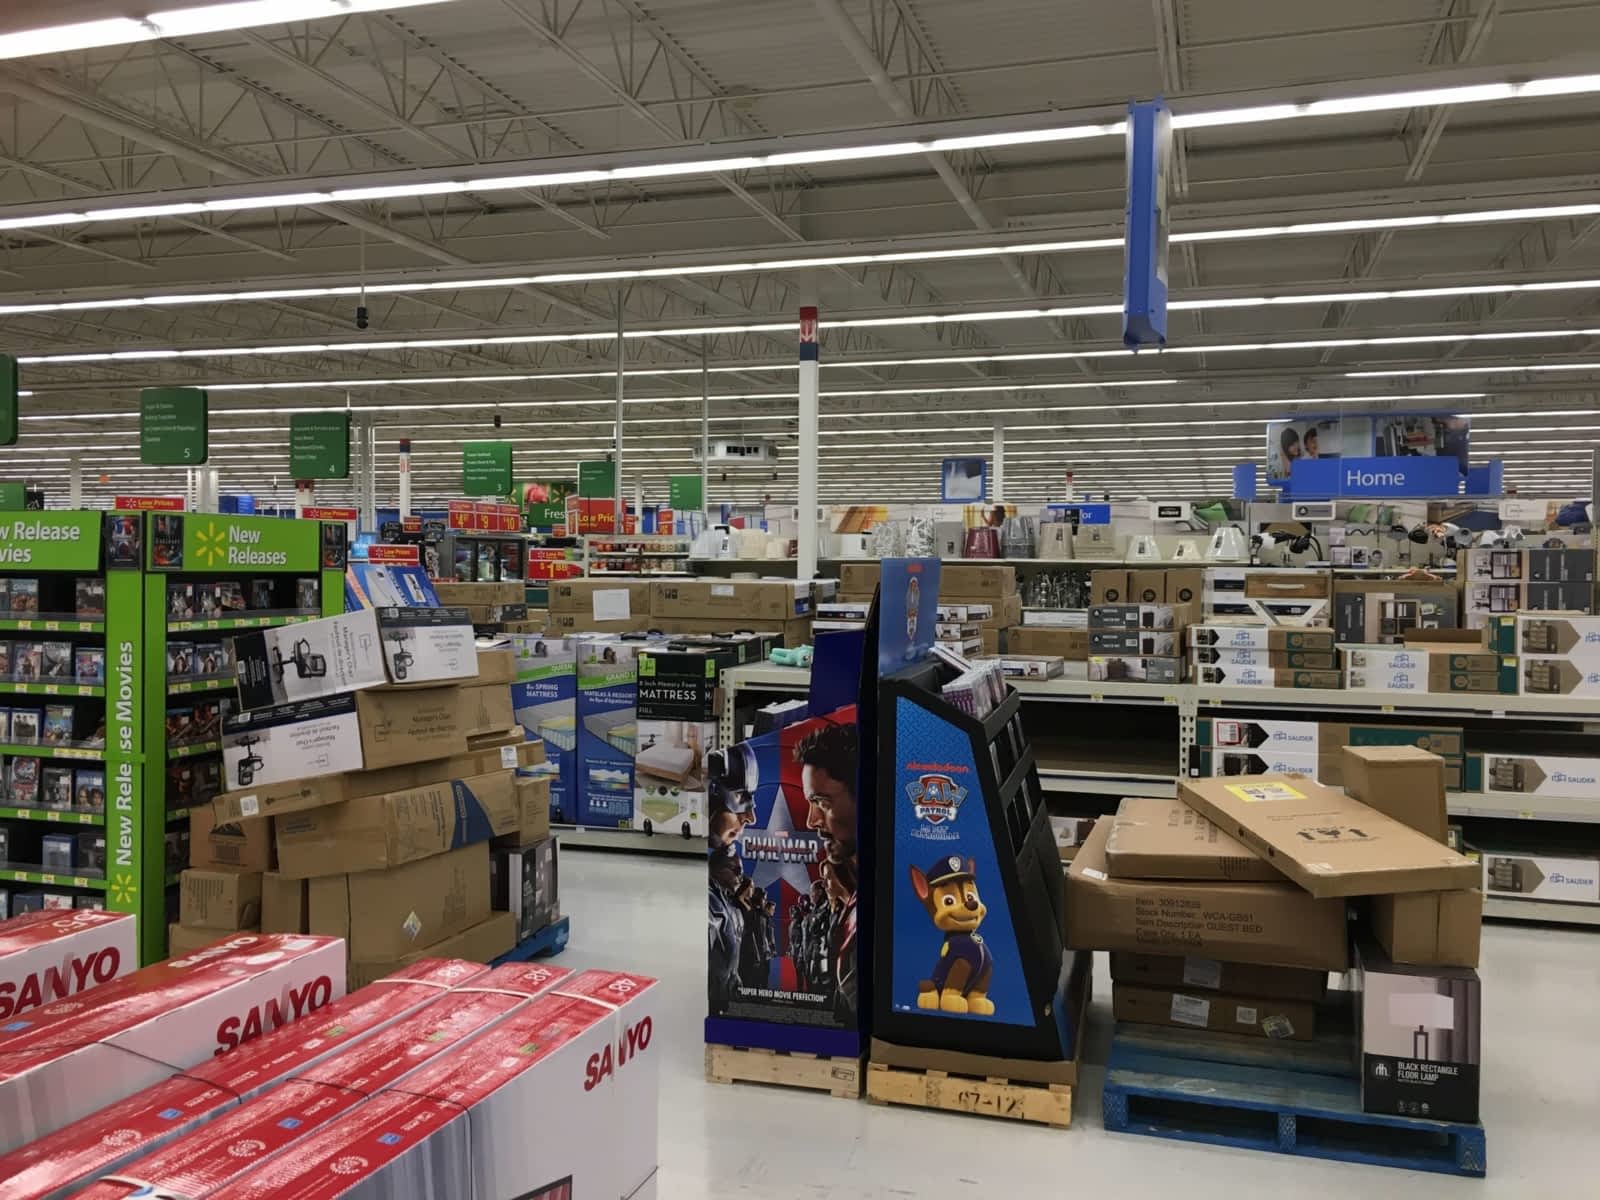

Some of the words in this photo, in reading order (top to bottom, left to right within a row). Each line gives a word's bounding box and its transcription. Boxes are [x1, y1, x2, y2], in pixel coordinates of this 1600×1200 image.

[184, 448, 191, 458] 5
[329, 464, 335, 473] 4
[1347, 469, 1405, 487] Home
[544, 508, 567, 519] Fres
[598, 513, 614, 522] Pric
[14, 521, 80, 540] Release
[229, 525, 261, 543] New
[0, 543, 32, 563] vies
[228, 546, 287, 565] Releases
[116, 641, 132, 721] Movies
[535, 683, 559, 691] SPRING
[639, 689, 697, 701] MATTRESS
[905, 781, 968, 808] PAW
[920, 807, 952, 817] PATROL
[116, 816, 132, 866] New
[742, 836, 779, 861] CIVIL
[782, 838, 819, 863] WAR
[1206, 921, 1239, 932] GUEST
[1242, 923, 1264, 933] BED
[0, 947, 120, 1019] SANYO
[758, 989, 773, 998] HERO
[773, 990, 792, 1000] MOVIE
[214, 975, 333, 1056] SANYO
[584, 1015, 652, 1092] SANYO
[1397, 1061, 1419, 1071] BLACK
[1420, 1063, 1459, 1076] RECTANGLE
[1397, 1070, 1419, 1080] FLOOR
[1420, 1072, 1439, 1082] LAMP
